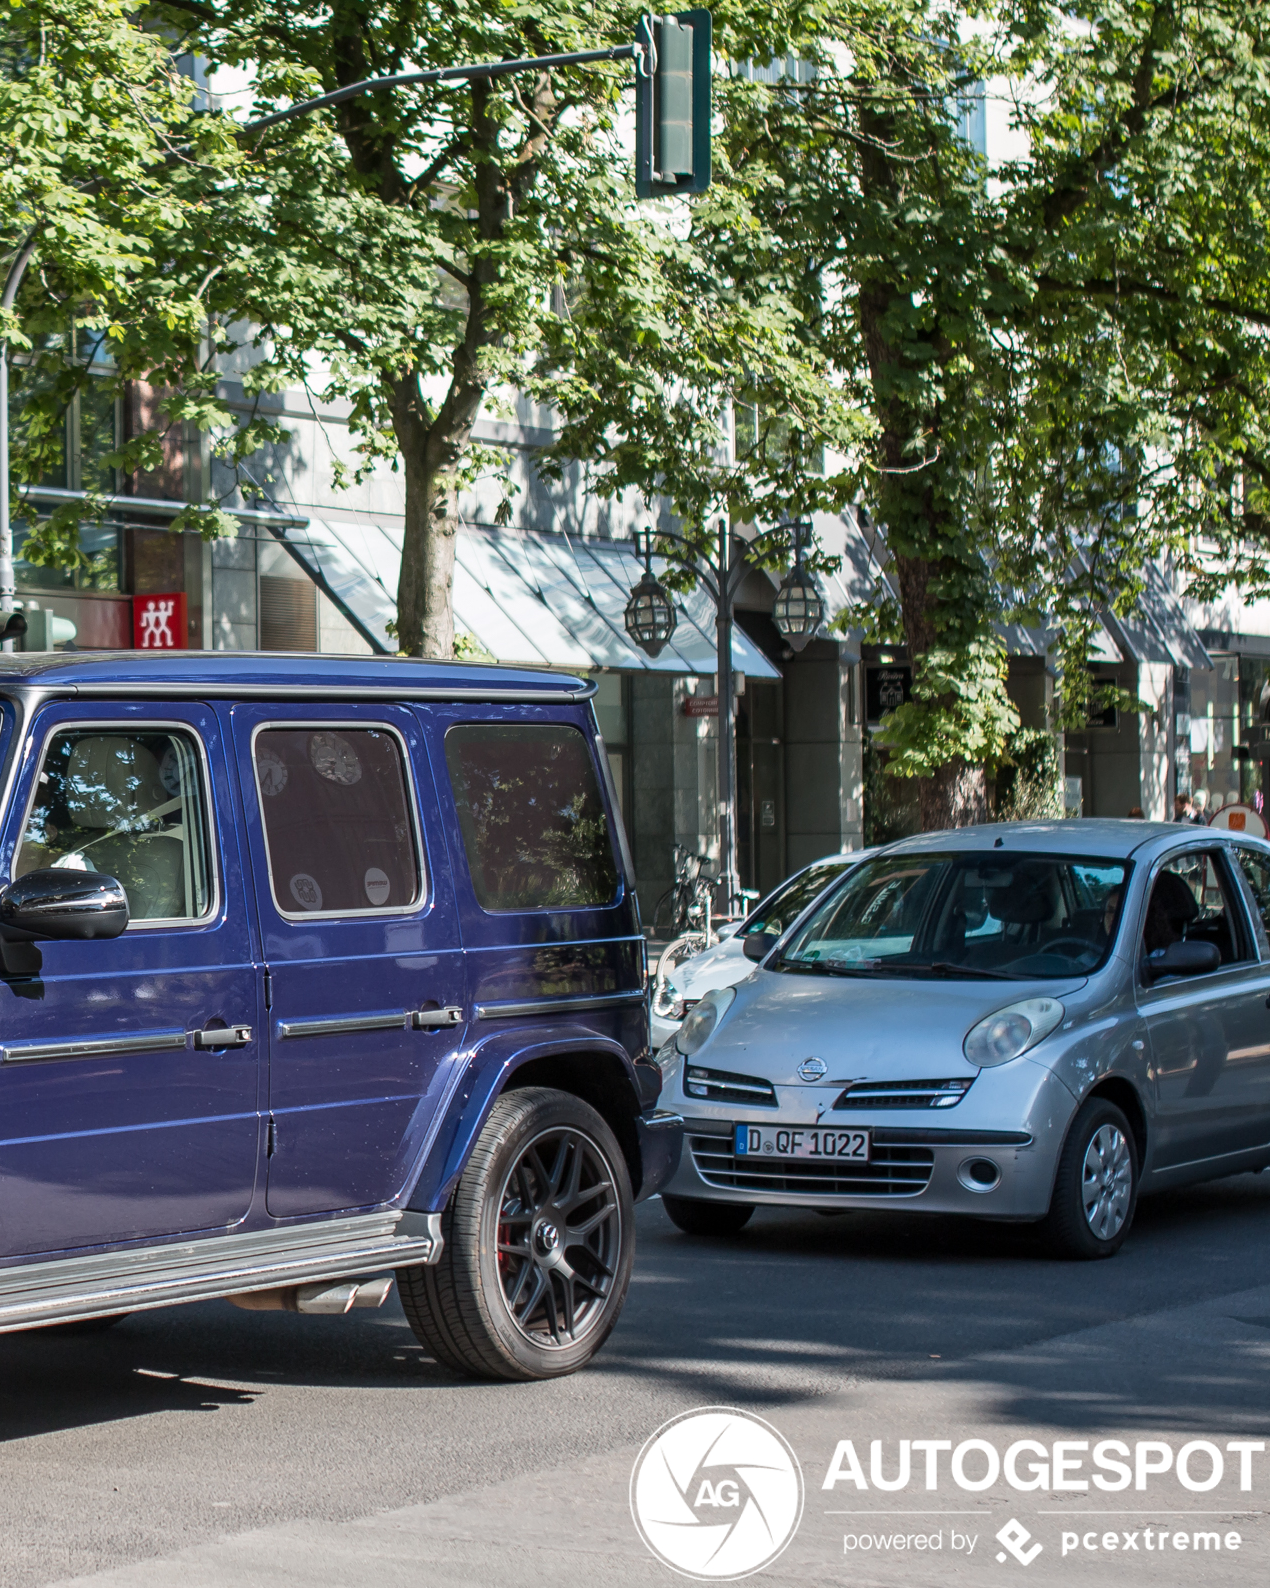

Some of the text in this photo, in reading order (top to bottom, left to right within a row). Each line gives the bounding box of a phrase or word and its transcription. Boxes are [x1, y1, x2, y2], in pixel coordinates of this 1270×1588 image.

[748, 1128, 866, 1157] D QF 1022
